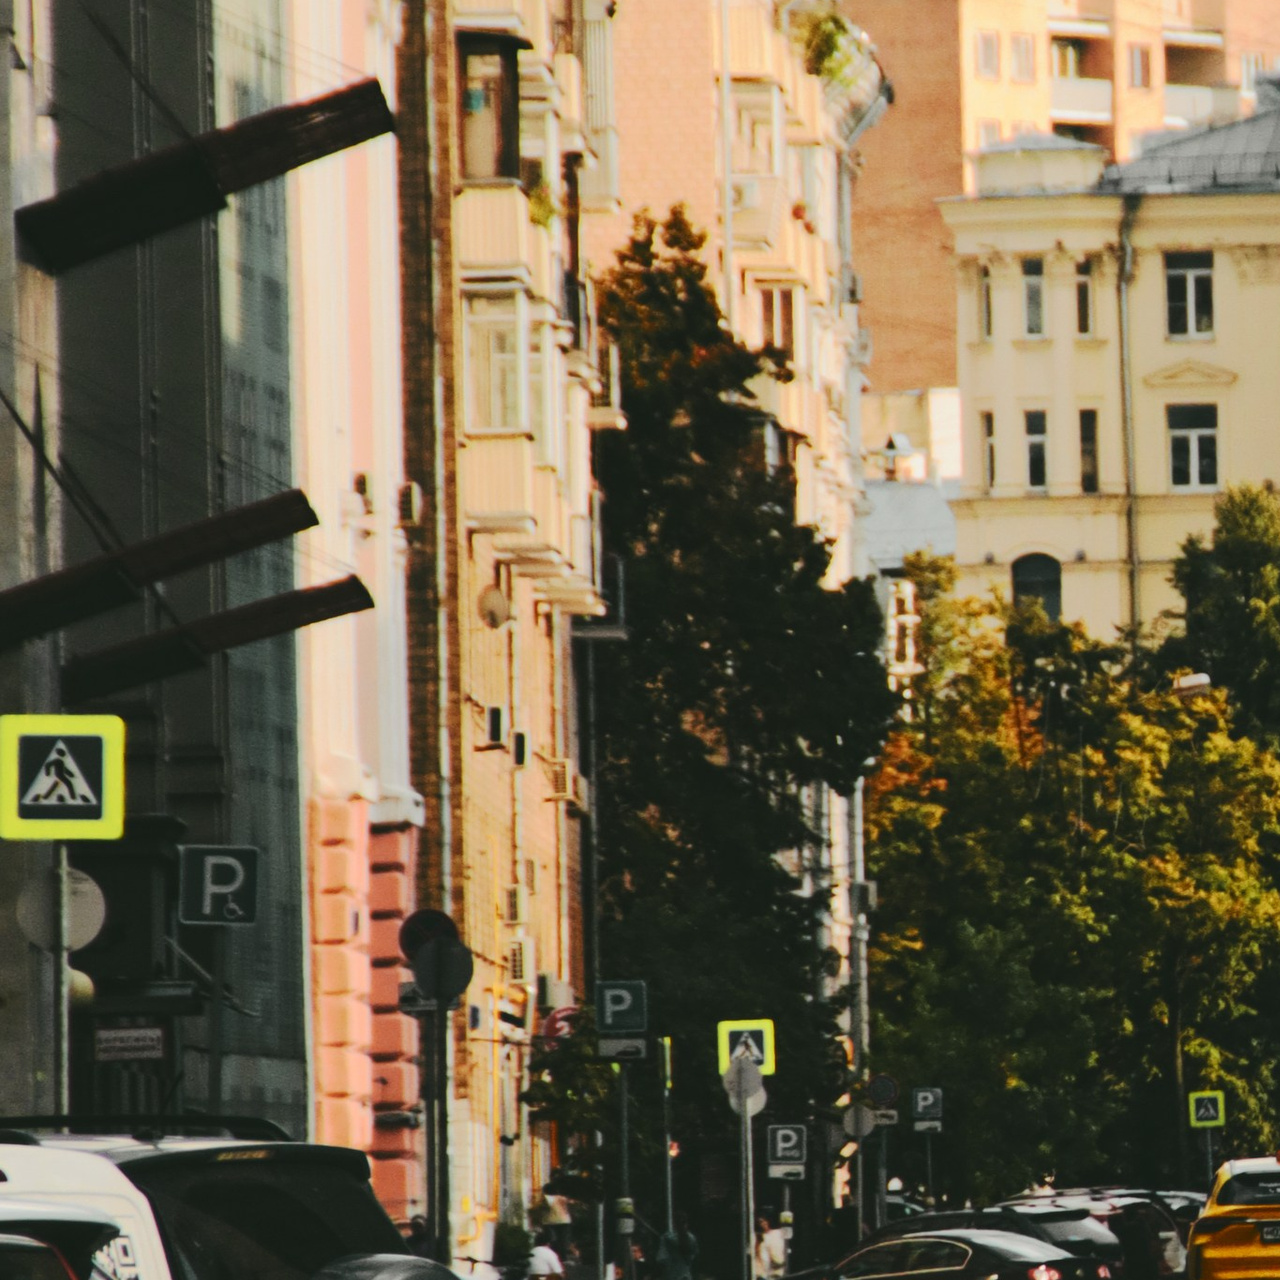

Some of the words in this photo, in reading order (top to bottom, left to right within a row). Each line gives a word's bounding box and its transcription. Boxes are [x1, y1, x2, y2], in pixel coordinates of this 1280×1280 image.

[202, 855, 245, 915] P
[604, 988, 633, 1025] P
[917, 1091, 935, 1112] P
[776, 1128, 798, 1158] P
